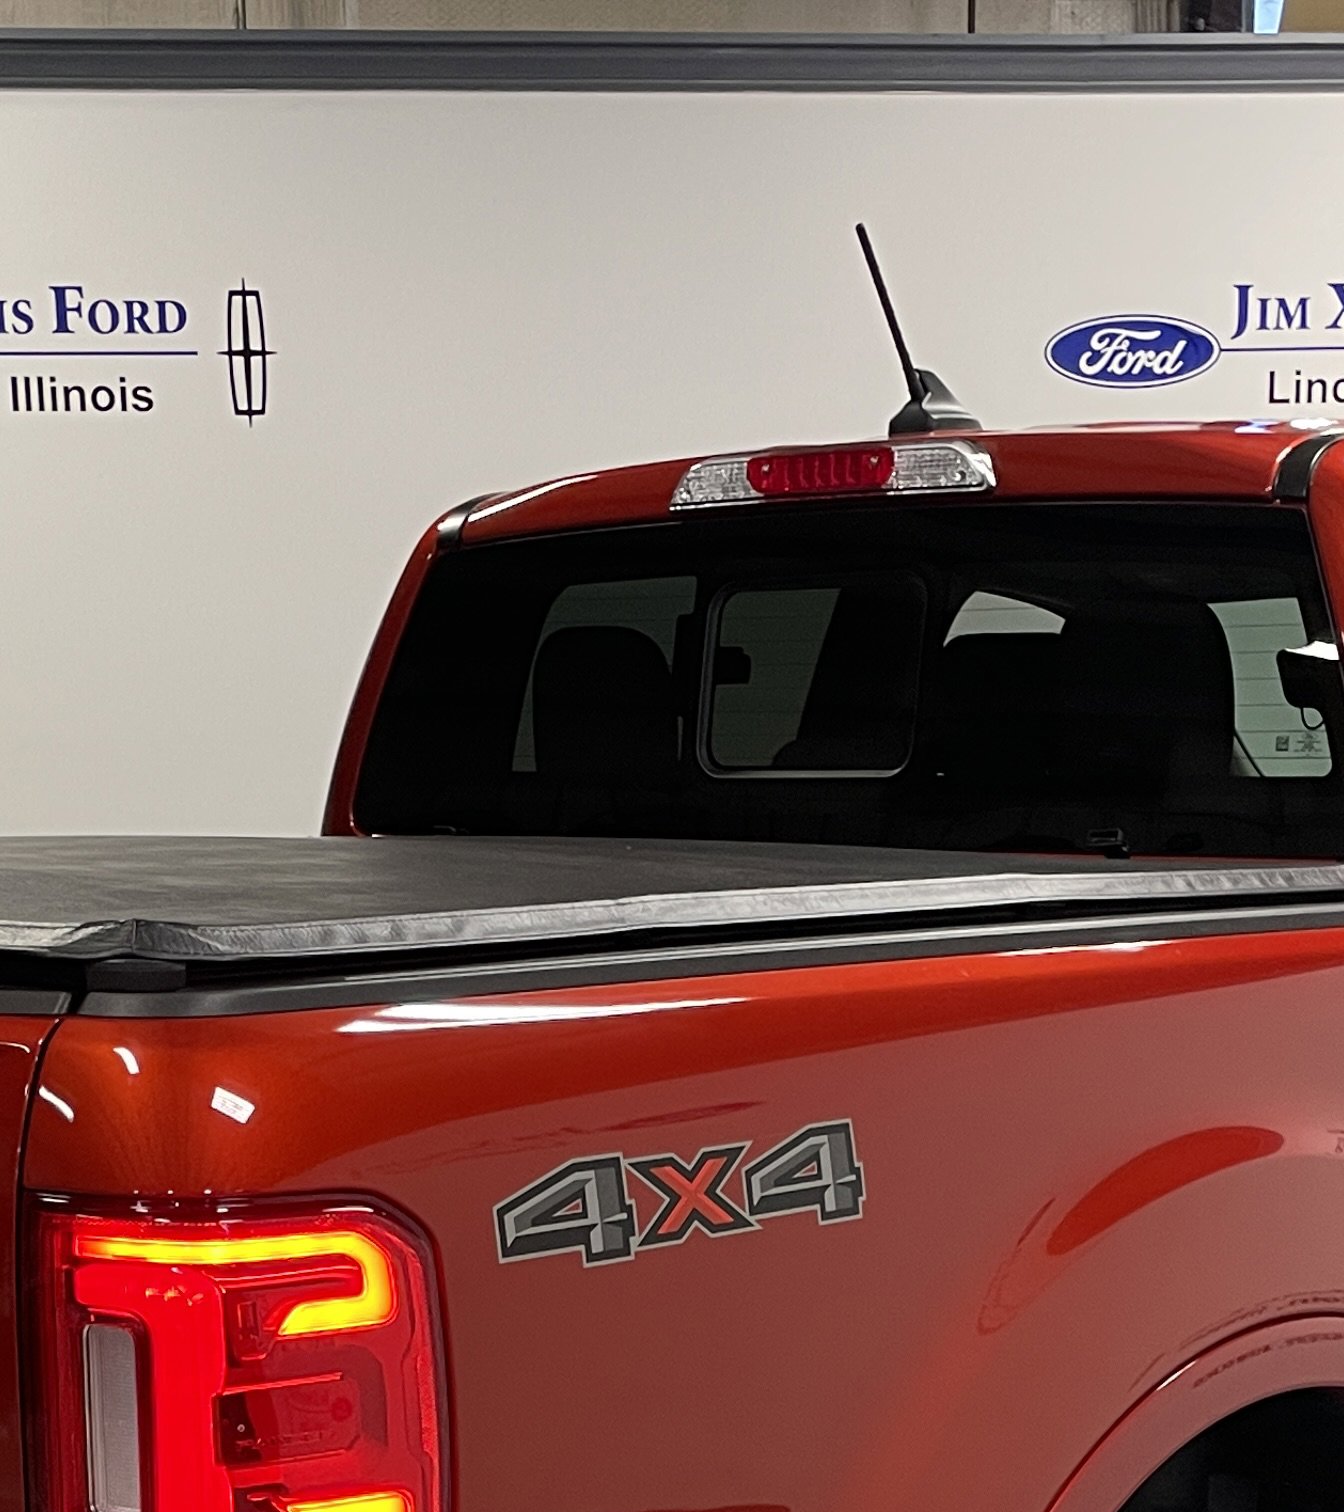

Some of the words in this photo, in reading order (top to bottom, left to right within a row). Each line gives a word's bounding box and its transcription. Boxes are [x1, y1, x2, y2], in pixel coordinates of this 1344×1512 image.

[48, 285, 187, 335] FORD
[1230, 284, 1310, 340] JIM
[1079, 328, 1187, 375] Ford
[10, 376, 154, 412] Illinois
